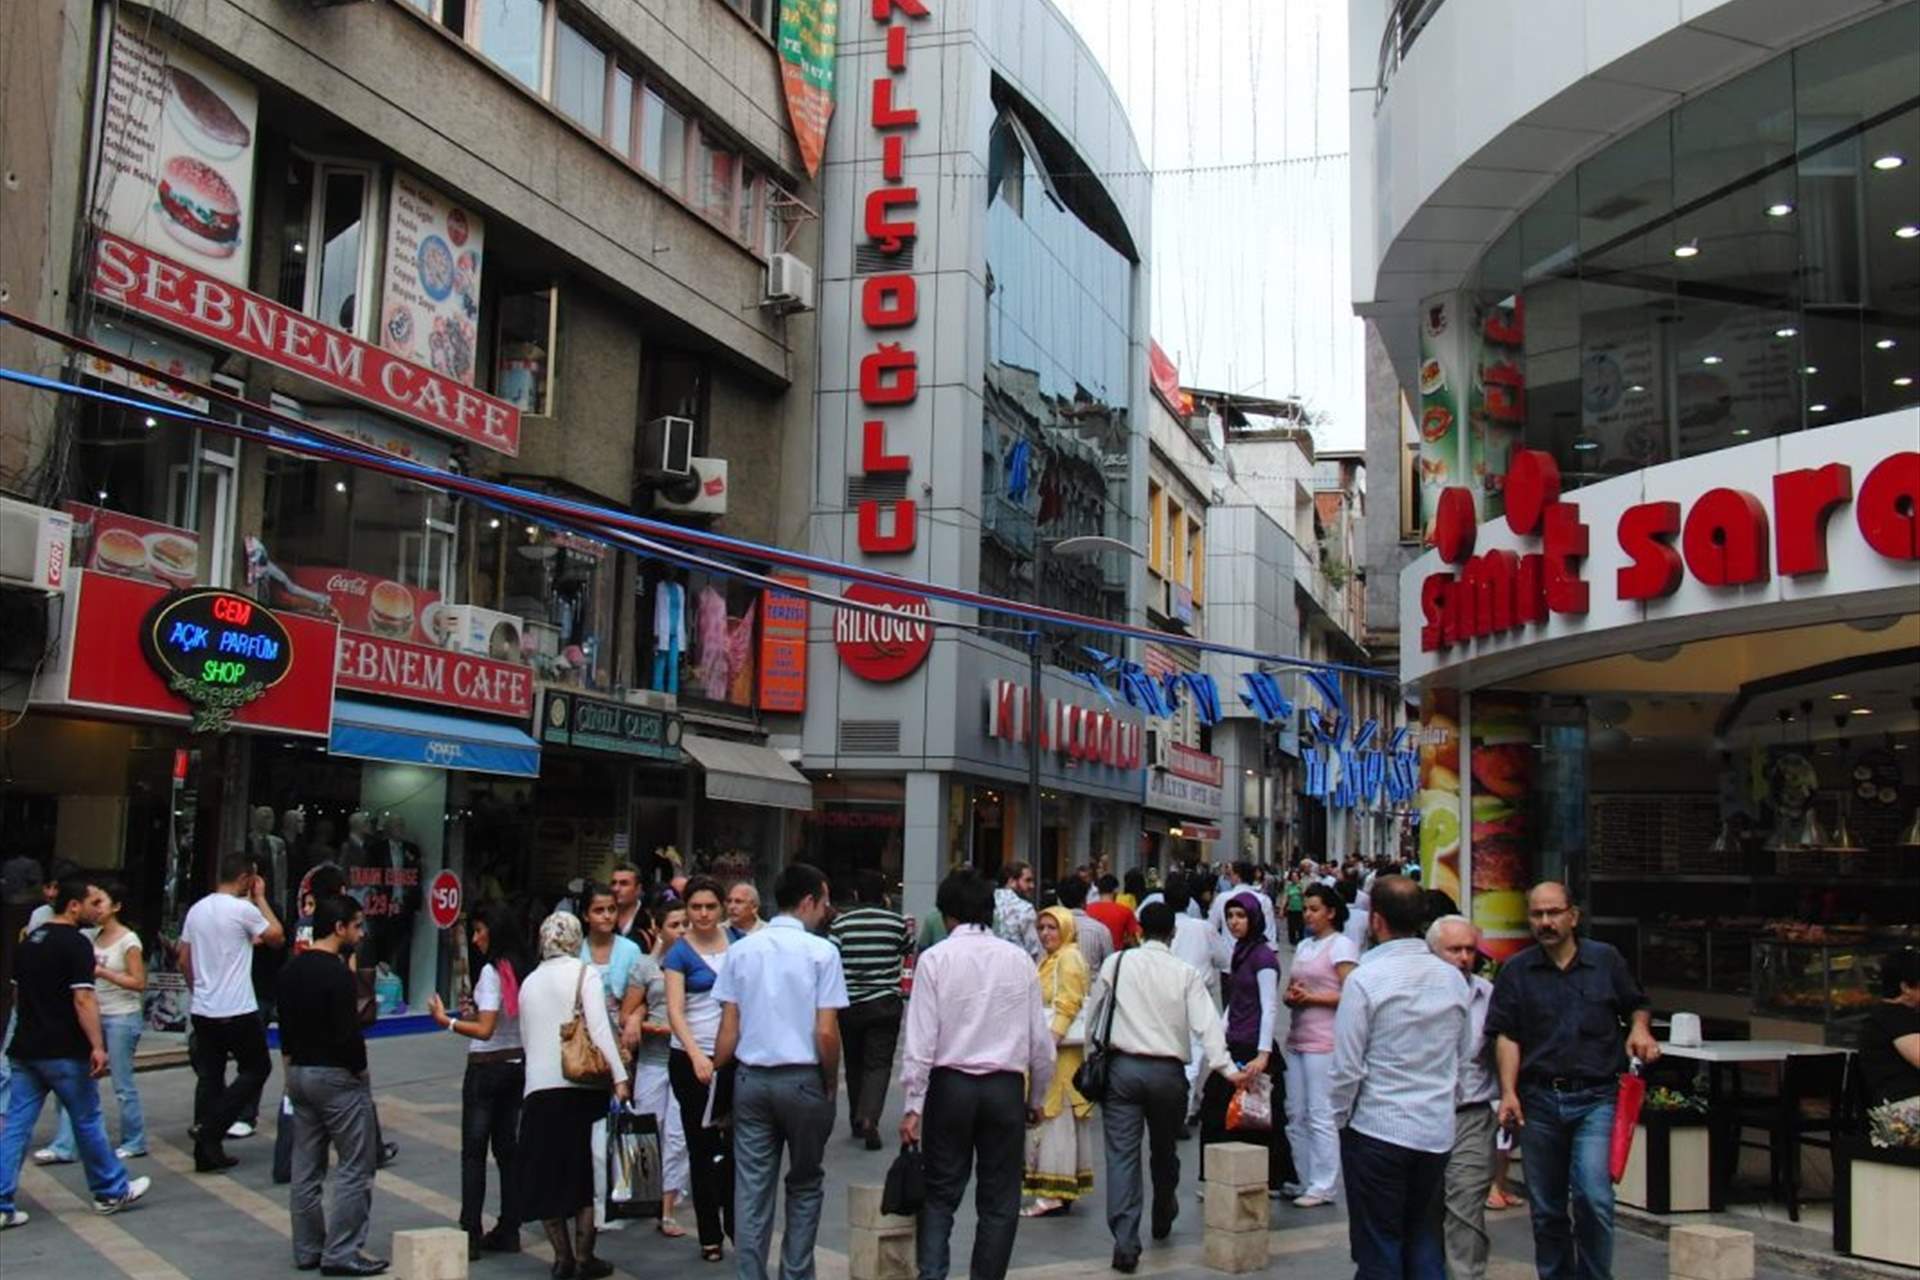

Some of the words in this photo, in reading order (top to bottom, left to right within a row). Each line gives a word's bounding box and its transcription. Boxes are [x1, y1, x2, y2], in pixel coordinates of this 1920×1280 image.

[381, 363, 509, 442] CAFE
[1420, 449, 1590, 652] simit
[214, 597, 252, 626] CEM
[170, 621, 209, 653] AÇIK
[202, 659, 246, 684] SHOP
[337, 637, 445, 692] EBNEM
[453, 661, 526, 705] CAFE
